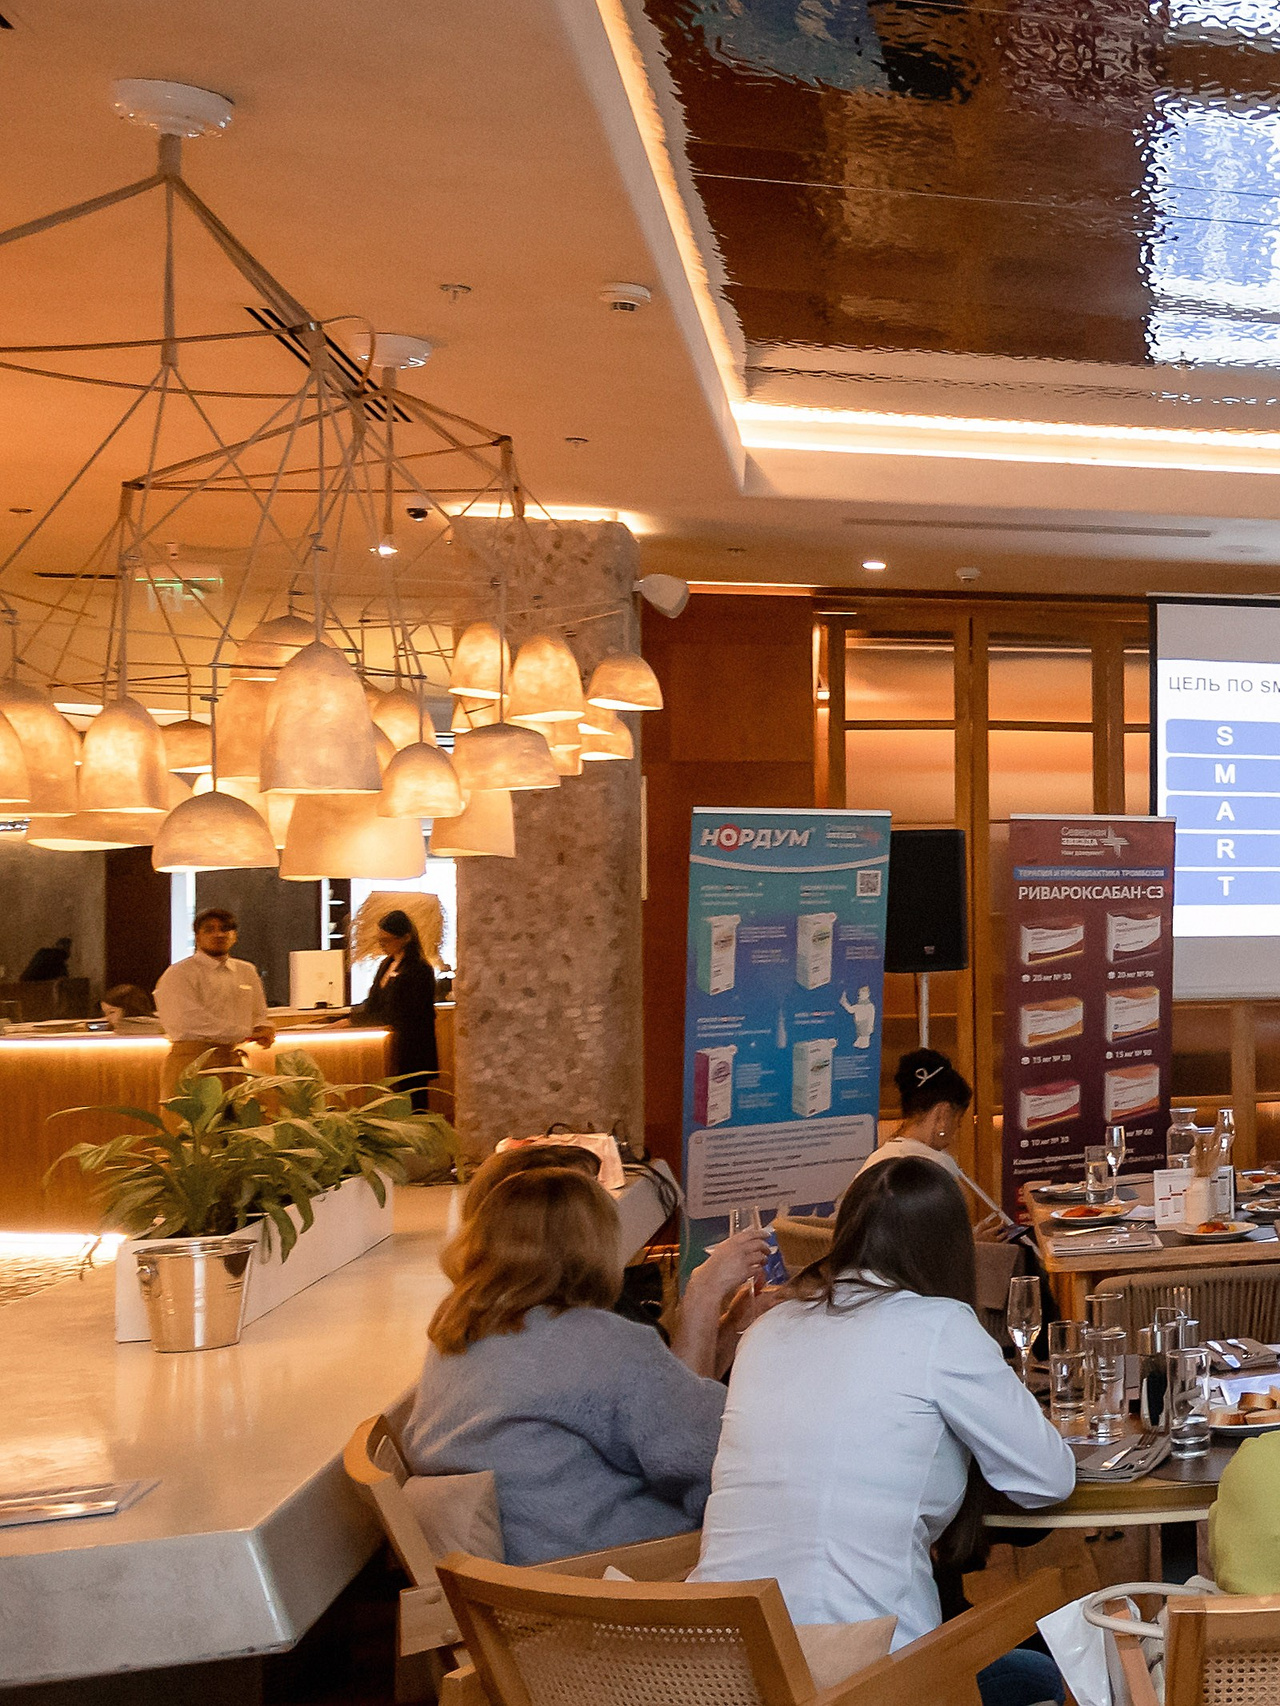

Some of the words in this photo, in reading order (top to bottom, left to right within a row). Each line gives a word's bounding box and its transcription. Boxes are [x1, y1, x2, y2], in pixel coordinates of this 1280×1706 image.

[1169, 676, 1220, 692] ЦЕЛЬ
[1228, 679, 1253, 692] ПО
[1216, 725, 1234, 746] S
[1214, 764, 1236, 784] M
[1216, 801, 1235, 822] A
[1061, 826, 1106, 836] Северная
[1217, 838, 1236, 859] R
[1018, 870, 1052, 878] ТЕРАПИЯ
[1217, 876, 1235, 896] T
